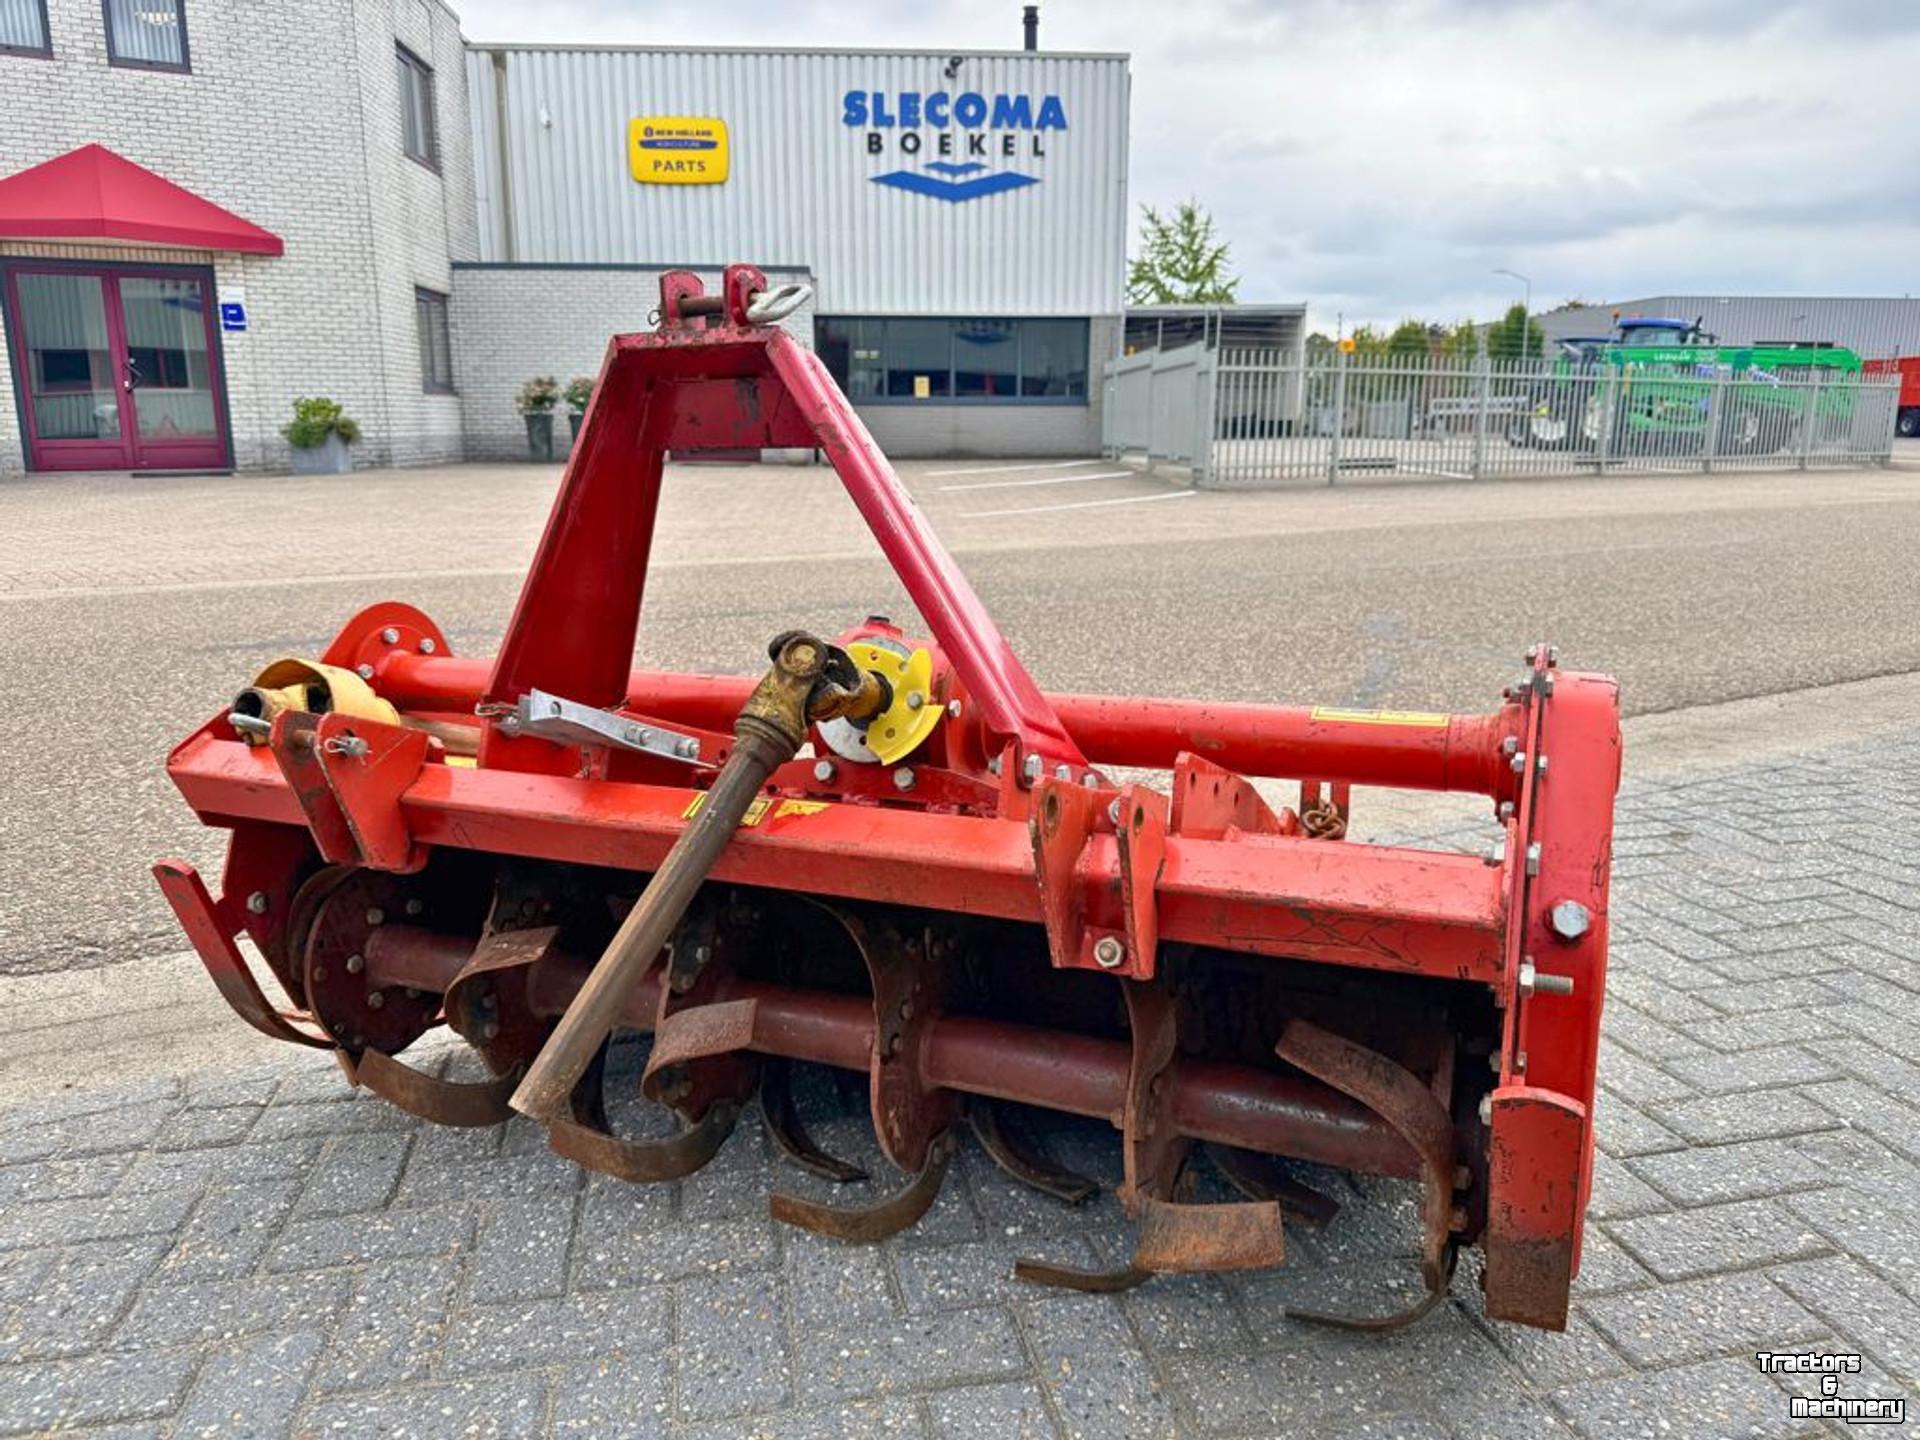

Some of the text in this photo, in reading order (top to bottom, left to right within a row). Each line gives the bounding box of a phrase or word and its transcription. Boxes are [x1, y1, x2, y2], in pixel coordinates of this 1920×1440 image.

[843, 90, 1067, 129] SLECOMA
[867, 132, 1045, 156] BOEKEL
[653, 160, 706, 172] PARTS
